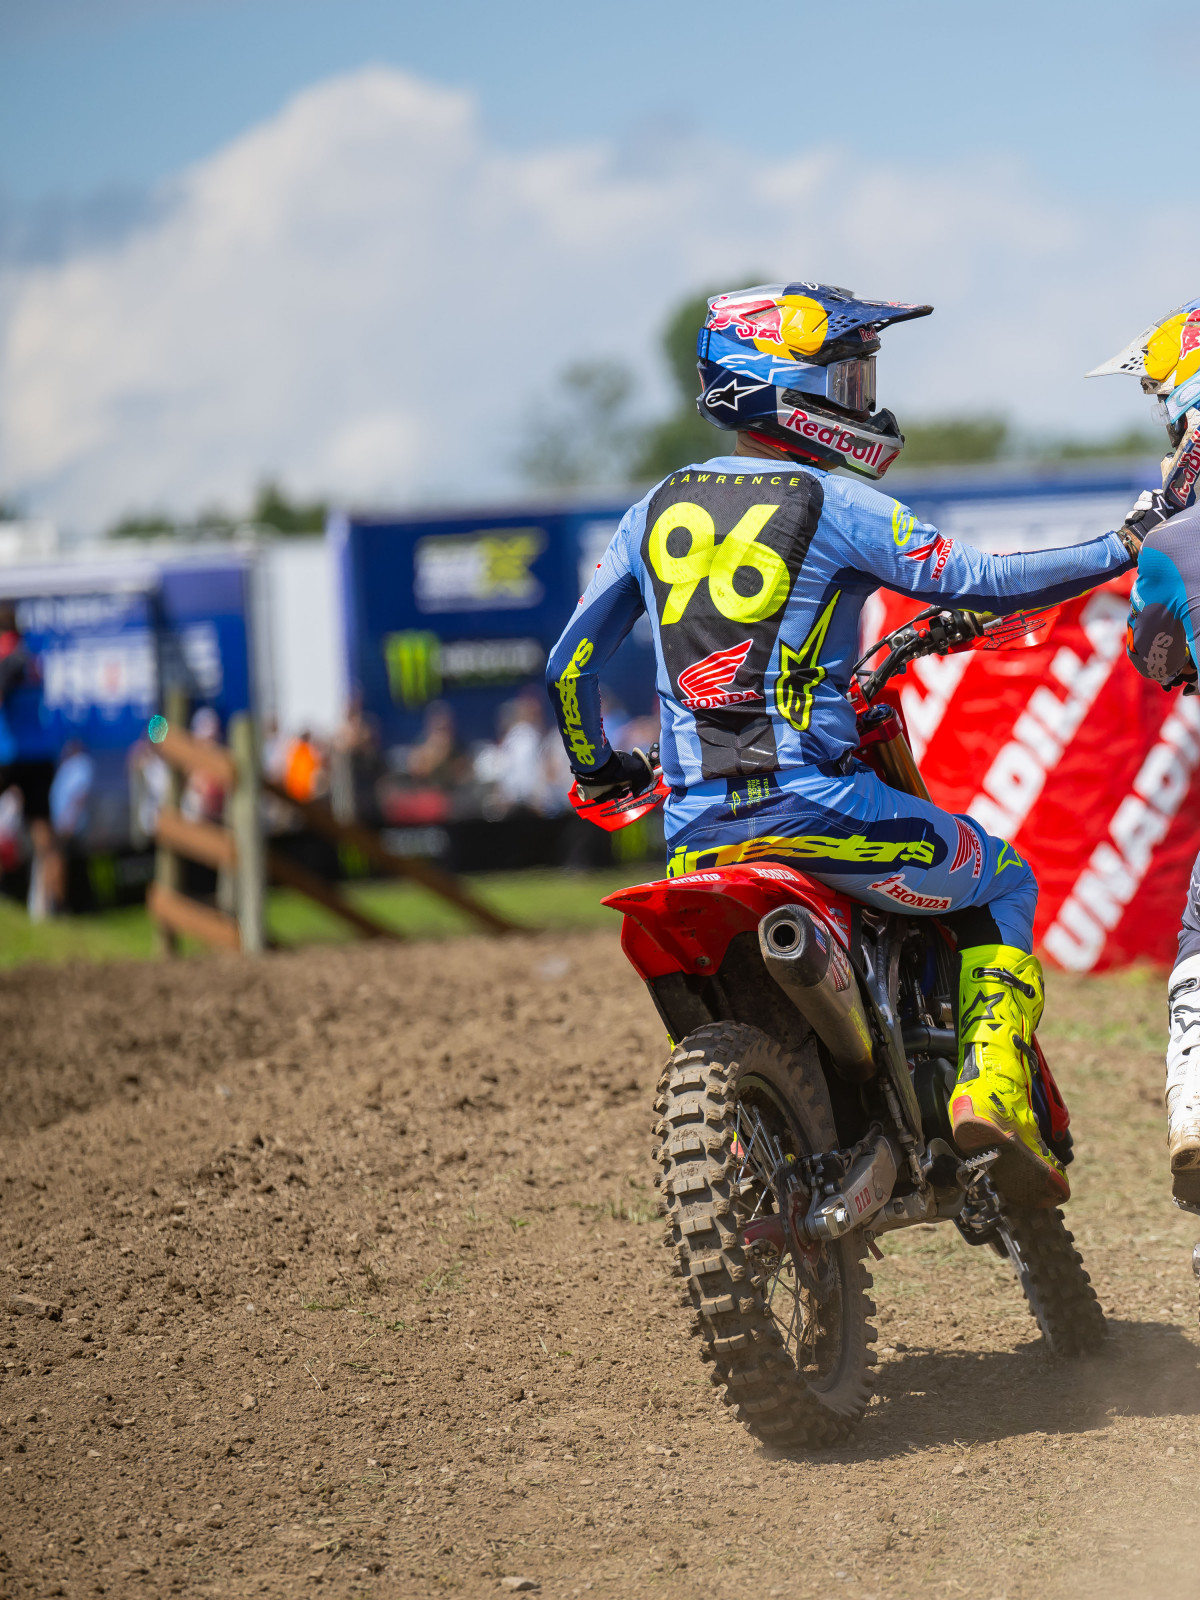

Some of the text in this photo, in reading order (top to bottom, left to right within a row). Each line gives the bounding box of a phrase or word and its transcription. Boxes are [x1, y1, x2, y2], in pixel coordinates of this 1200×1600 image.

[669, 473, 800, 487] LAWRENCE
[648, 501, 790, 625] 96
[681, 690, 764, 711] HONDA
[966, 592, 1128, 842] ADILLA
[886, 884, 950, 910] HONDA
